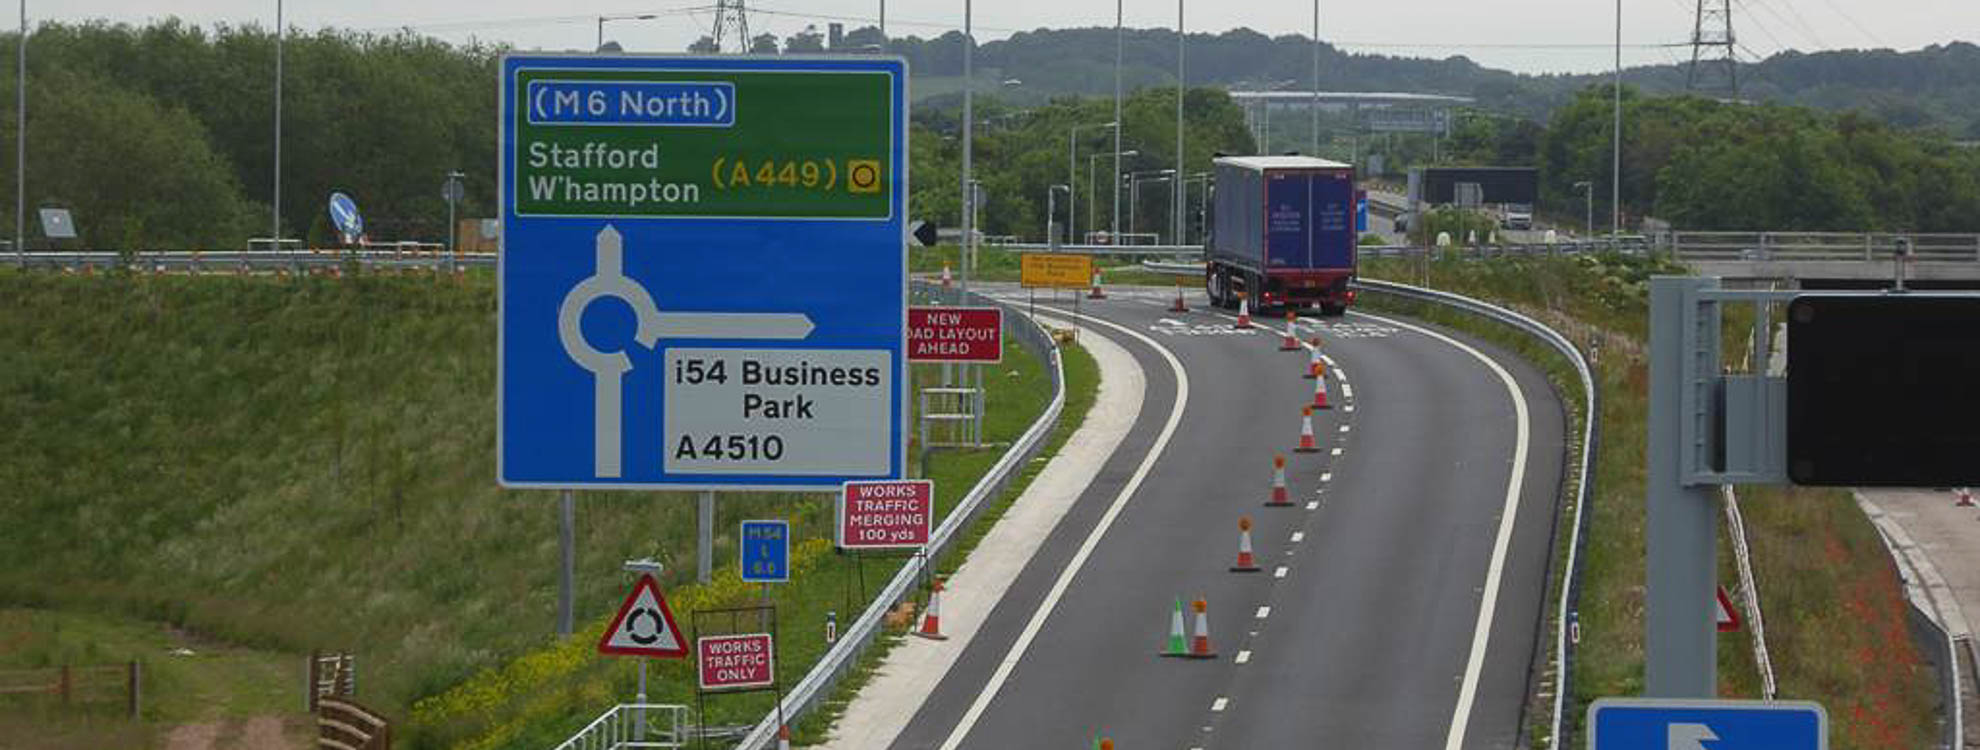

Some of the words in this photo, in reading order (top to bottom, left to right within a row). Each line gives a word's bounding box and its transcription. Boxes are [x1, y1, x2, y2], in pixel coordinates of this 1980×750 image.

[621, 89, 728, 120] North)
[529, 142, 658, 169] Stafford
[712, 158, 836, 190] (A449)
[529, 176, 699, 206] W'hampton
[928, 313, 961, 325] NEW
[907, 328, 934, 340] OAD
[939, 328, 994, 340] LAYOUT
[917, 342, 969, 354] AHEAD
[676, 360, 727, 385] i54
[742, 361, 880, 386] Business
[743, 394, 814, 419] Park
[675, 435, 784, 460] A4510
[860, 485, 916, 497] WORKS
[856, 499, 919, 511] TRAFFIC
[850, 513, 924, 526] MERGING
[859, 529, 886, 540] 100
[890, 528, 915, 541] yds
[709, 639, 761, 654] WORKS
[707, 653, 765, 668] TRAFFIC
[717, 666, 757, 681] ONLY
